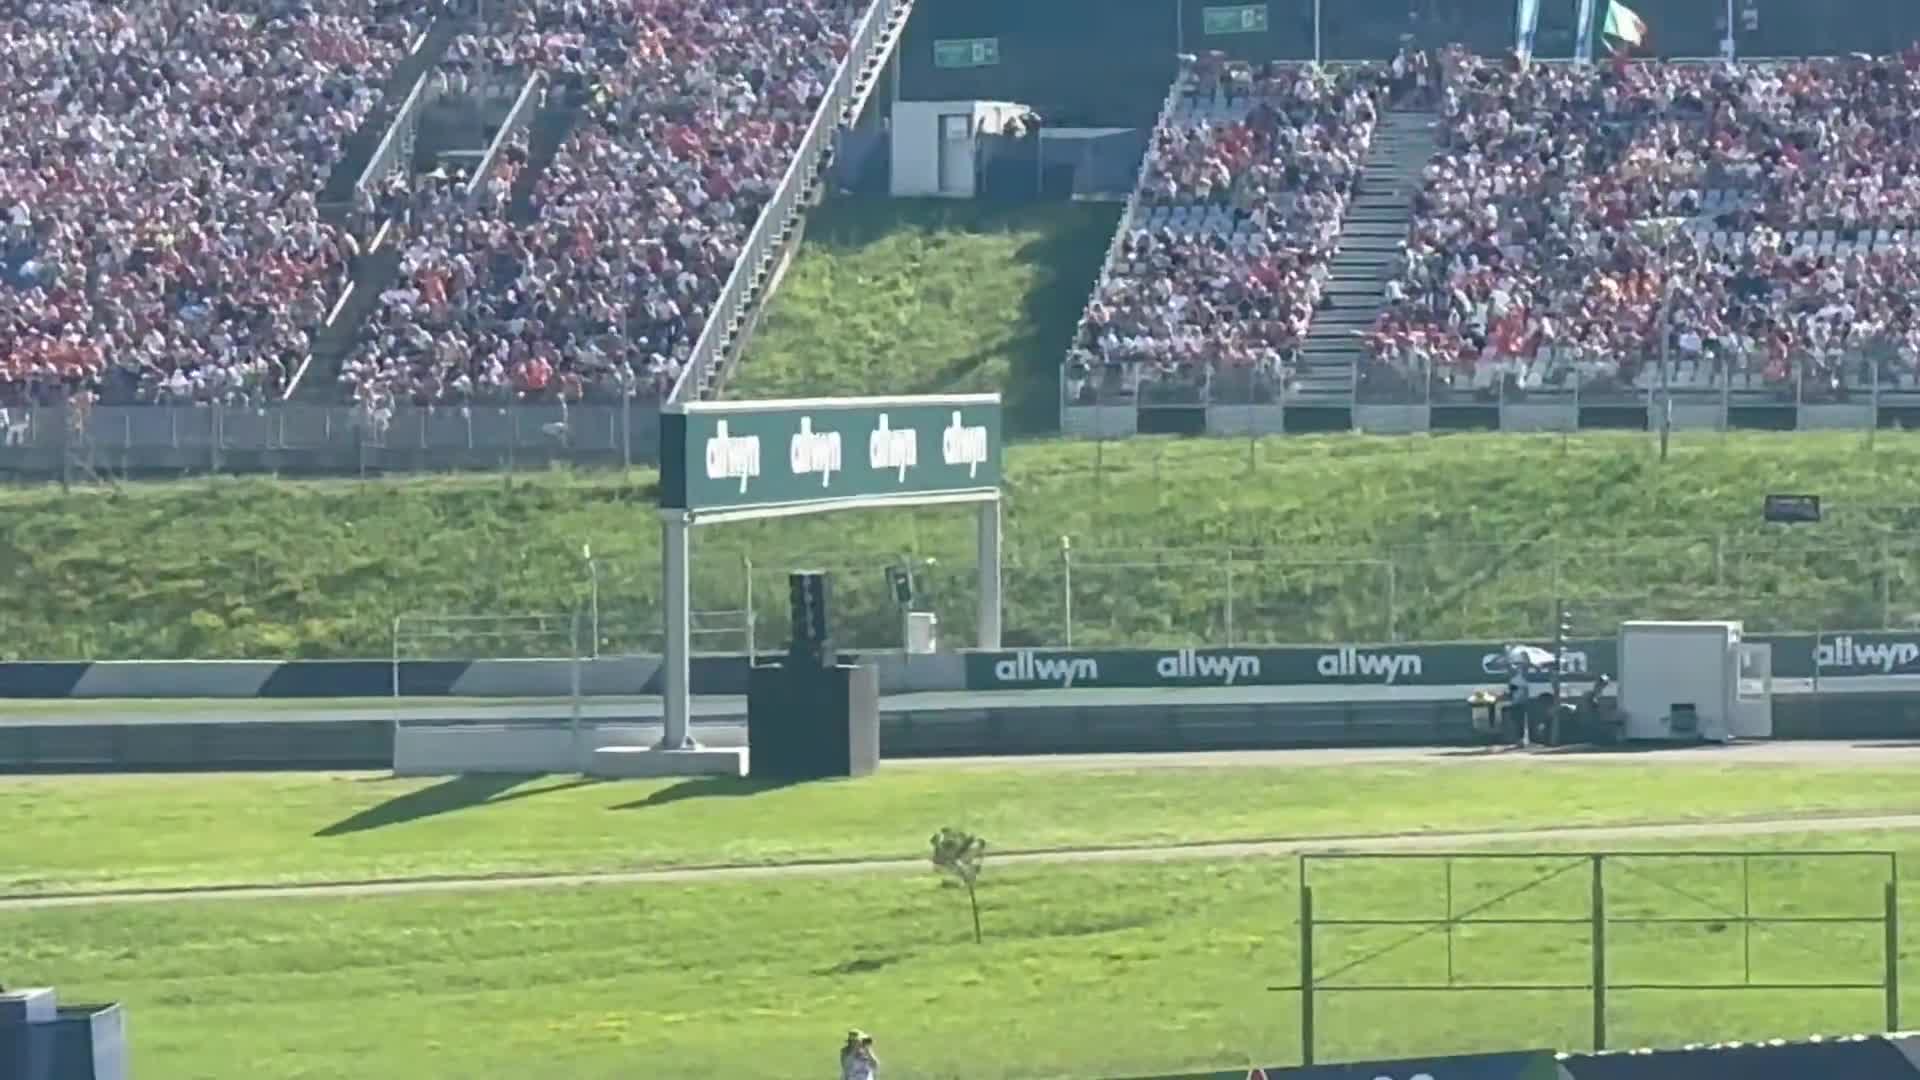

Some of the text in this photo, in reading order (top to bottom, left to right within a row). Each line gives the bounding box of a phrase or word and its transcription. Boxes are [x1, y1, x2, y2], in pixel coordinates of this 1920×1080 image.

[995, 647, 1421, 688] allwyn allwyn allwyn
